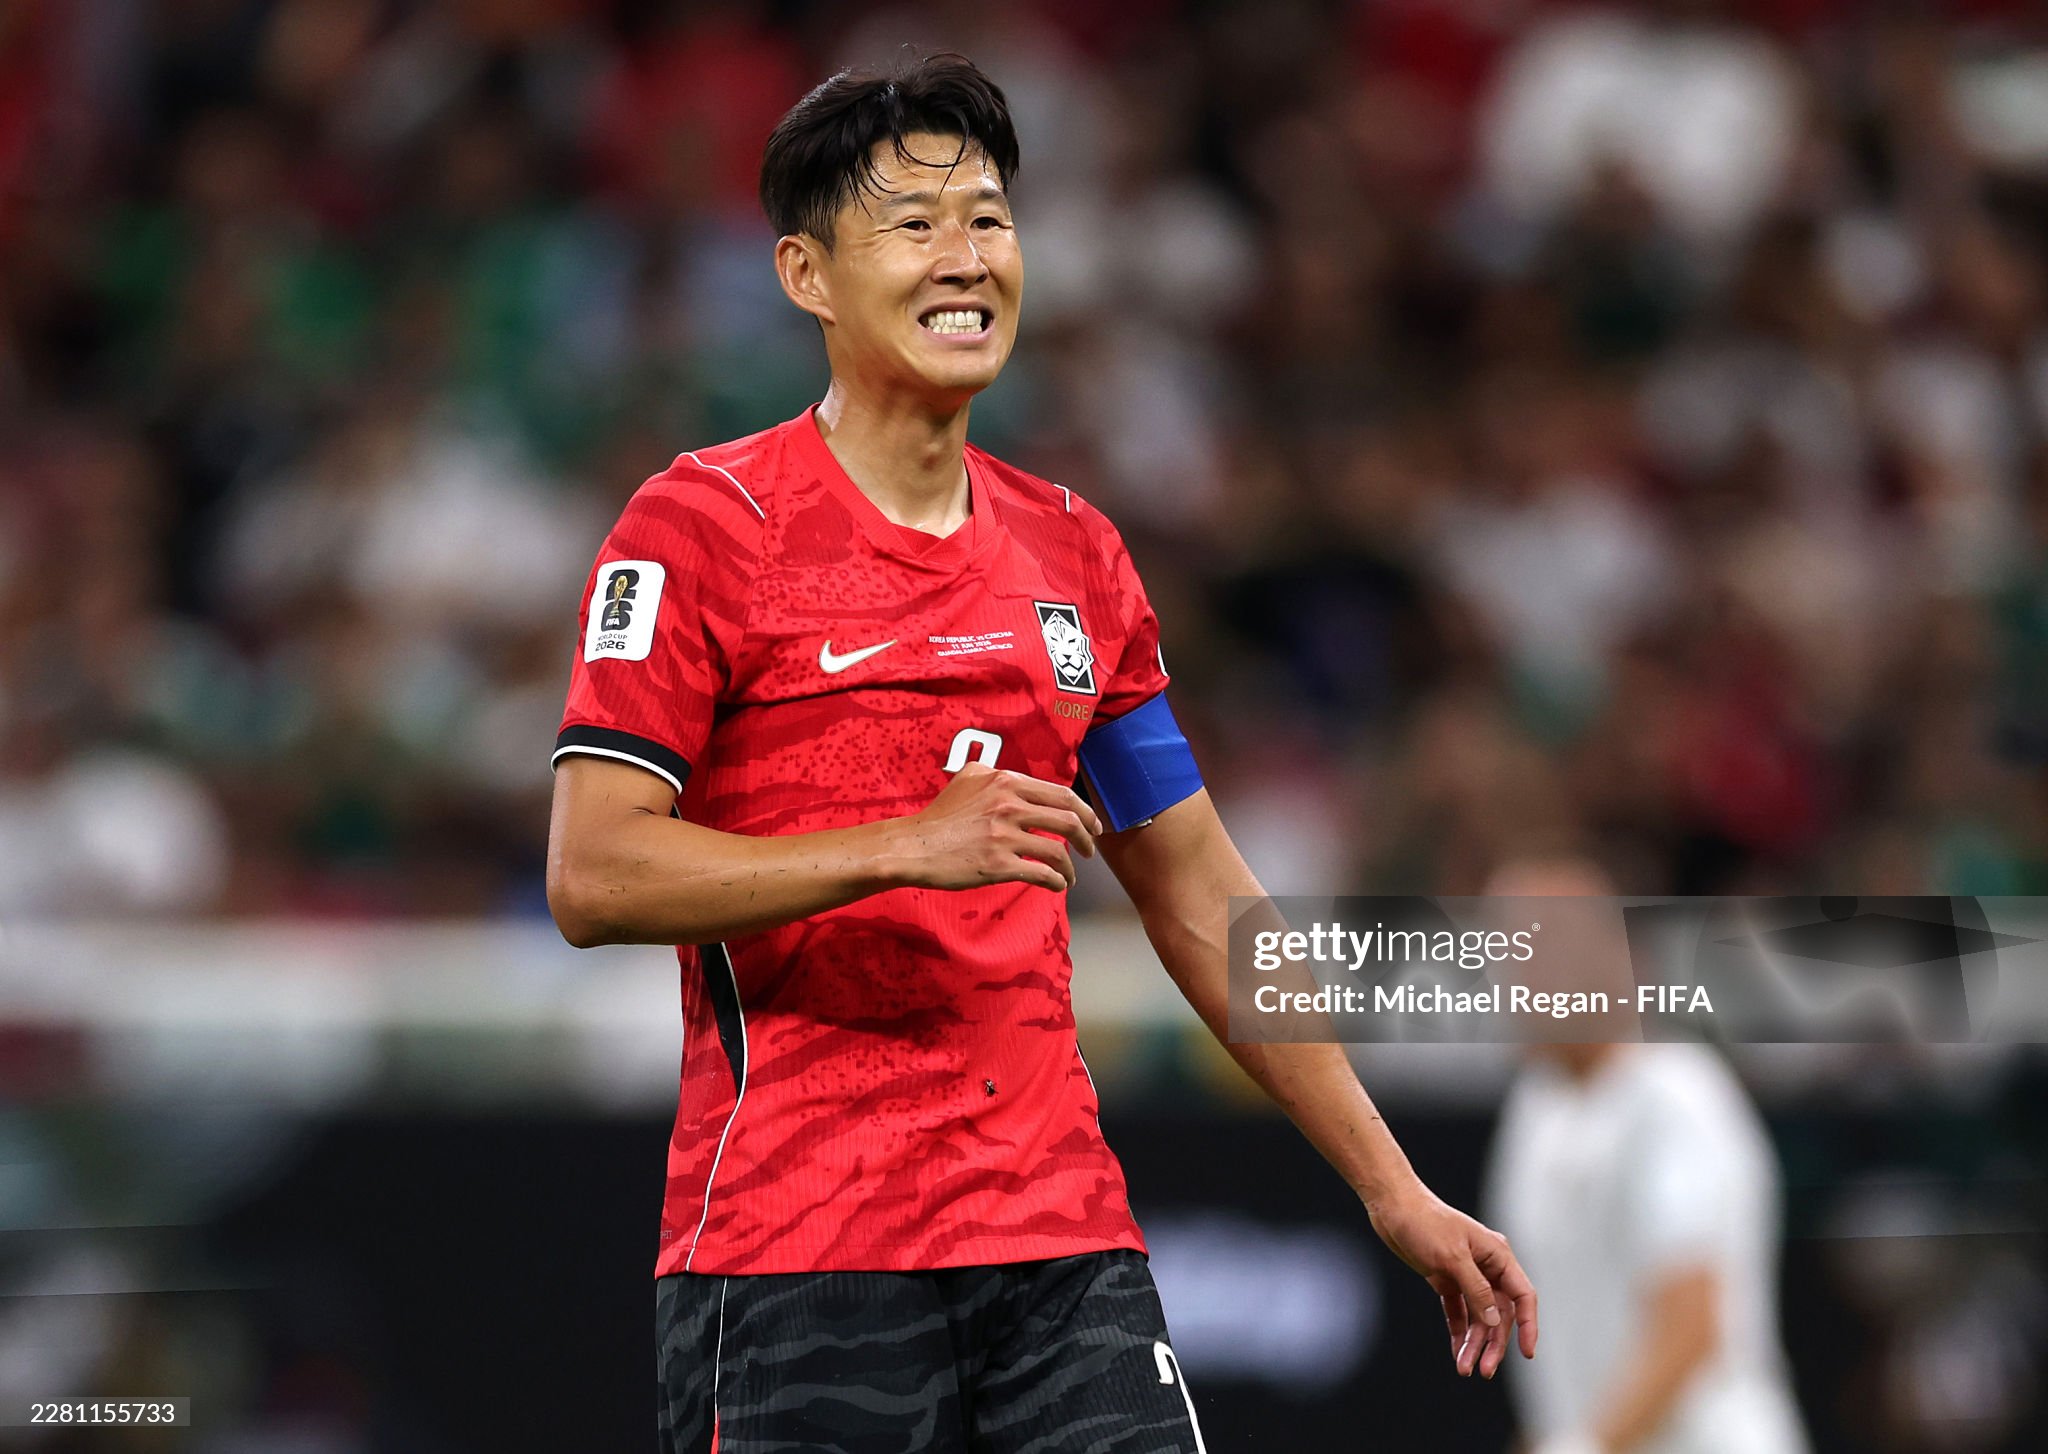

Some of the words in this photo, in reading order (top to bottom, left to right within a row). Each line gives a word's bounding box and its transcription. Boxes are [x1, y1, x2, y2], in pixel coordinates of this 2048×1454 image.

[605, 617, 620, 627] FIFA
[595, 640, 626, 652] 2026
[1054, 700, 1093, 720] KORE
